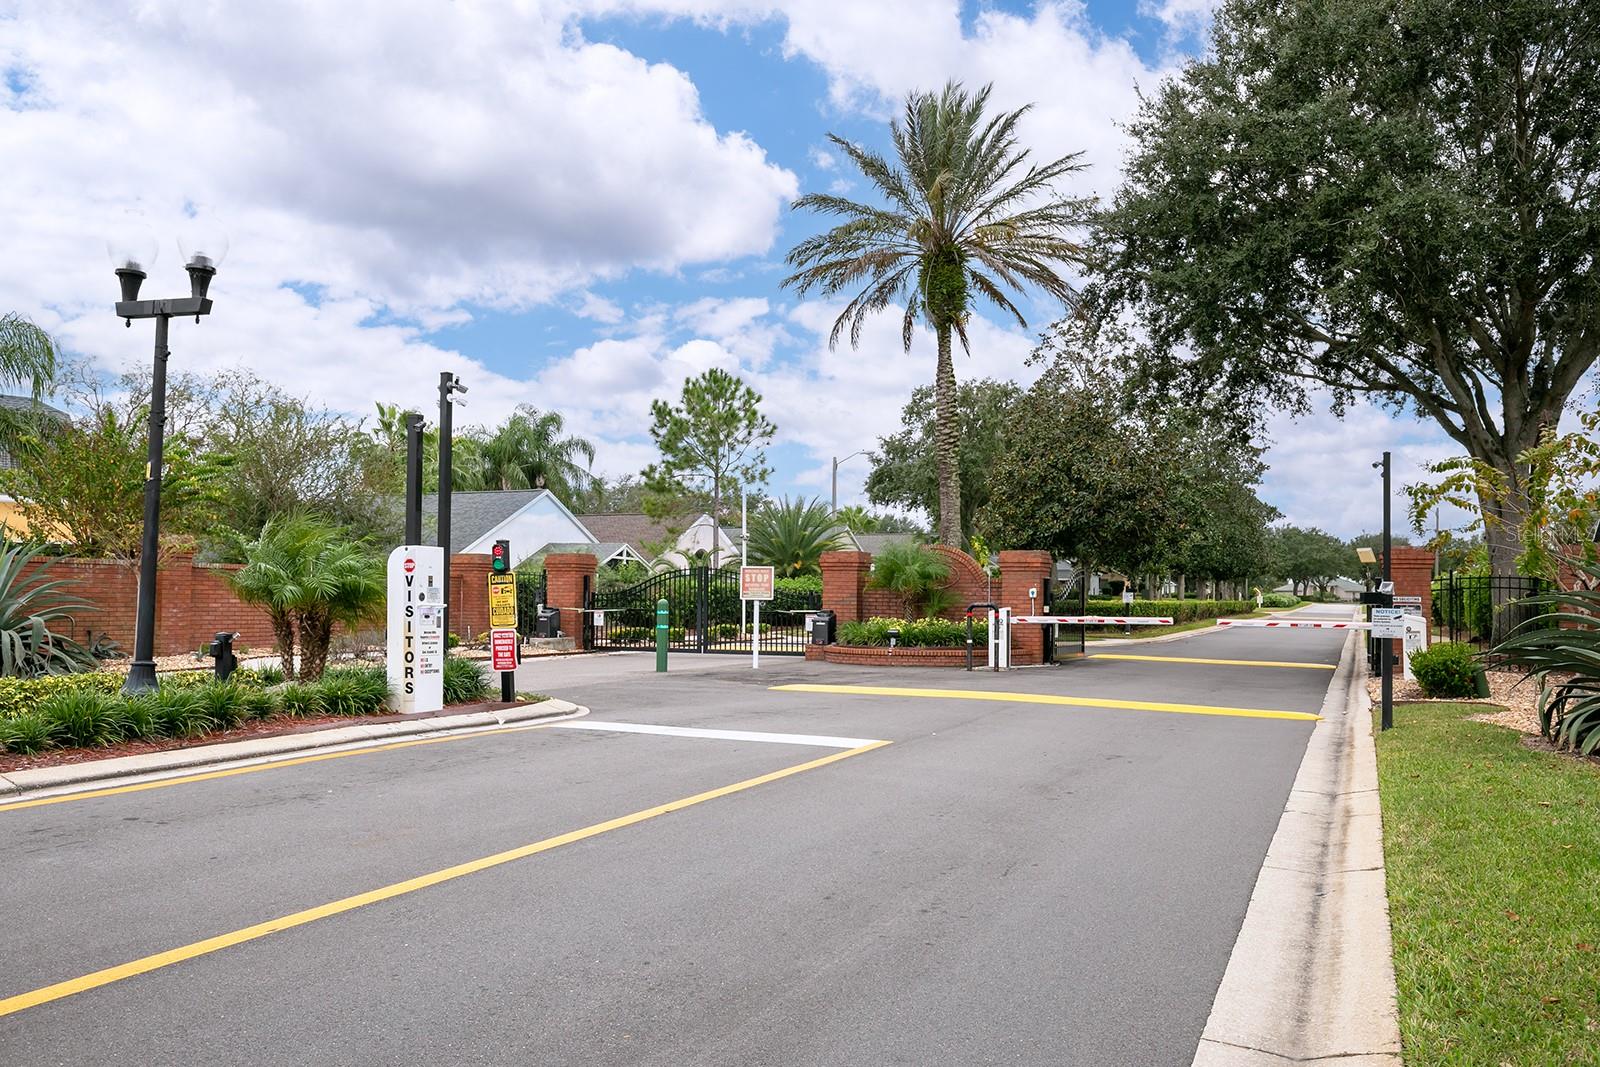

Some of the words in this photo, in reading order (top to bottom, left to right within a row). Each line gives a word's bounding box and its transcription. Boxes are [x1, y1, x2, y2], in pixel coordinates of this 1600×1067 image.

[492, 575, 513, 584] CAUTION
[745, 574, 769, 582] STOP
[405, 575, 414, 694] VISITORS
